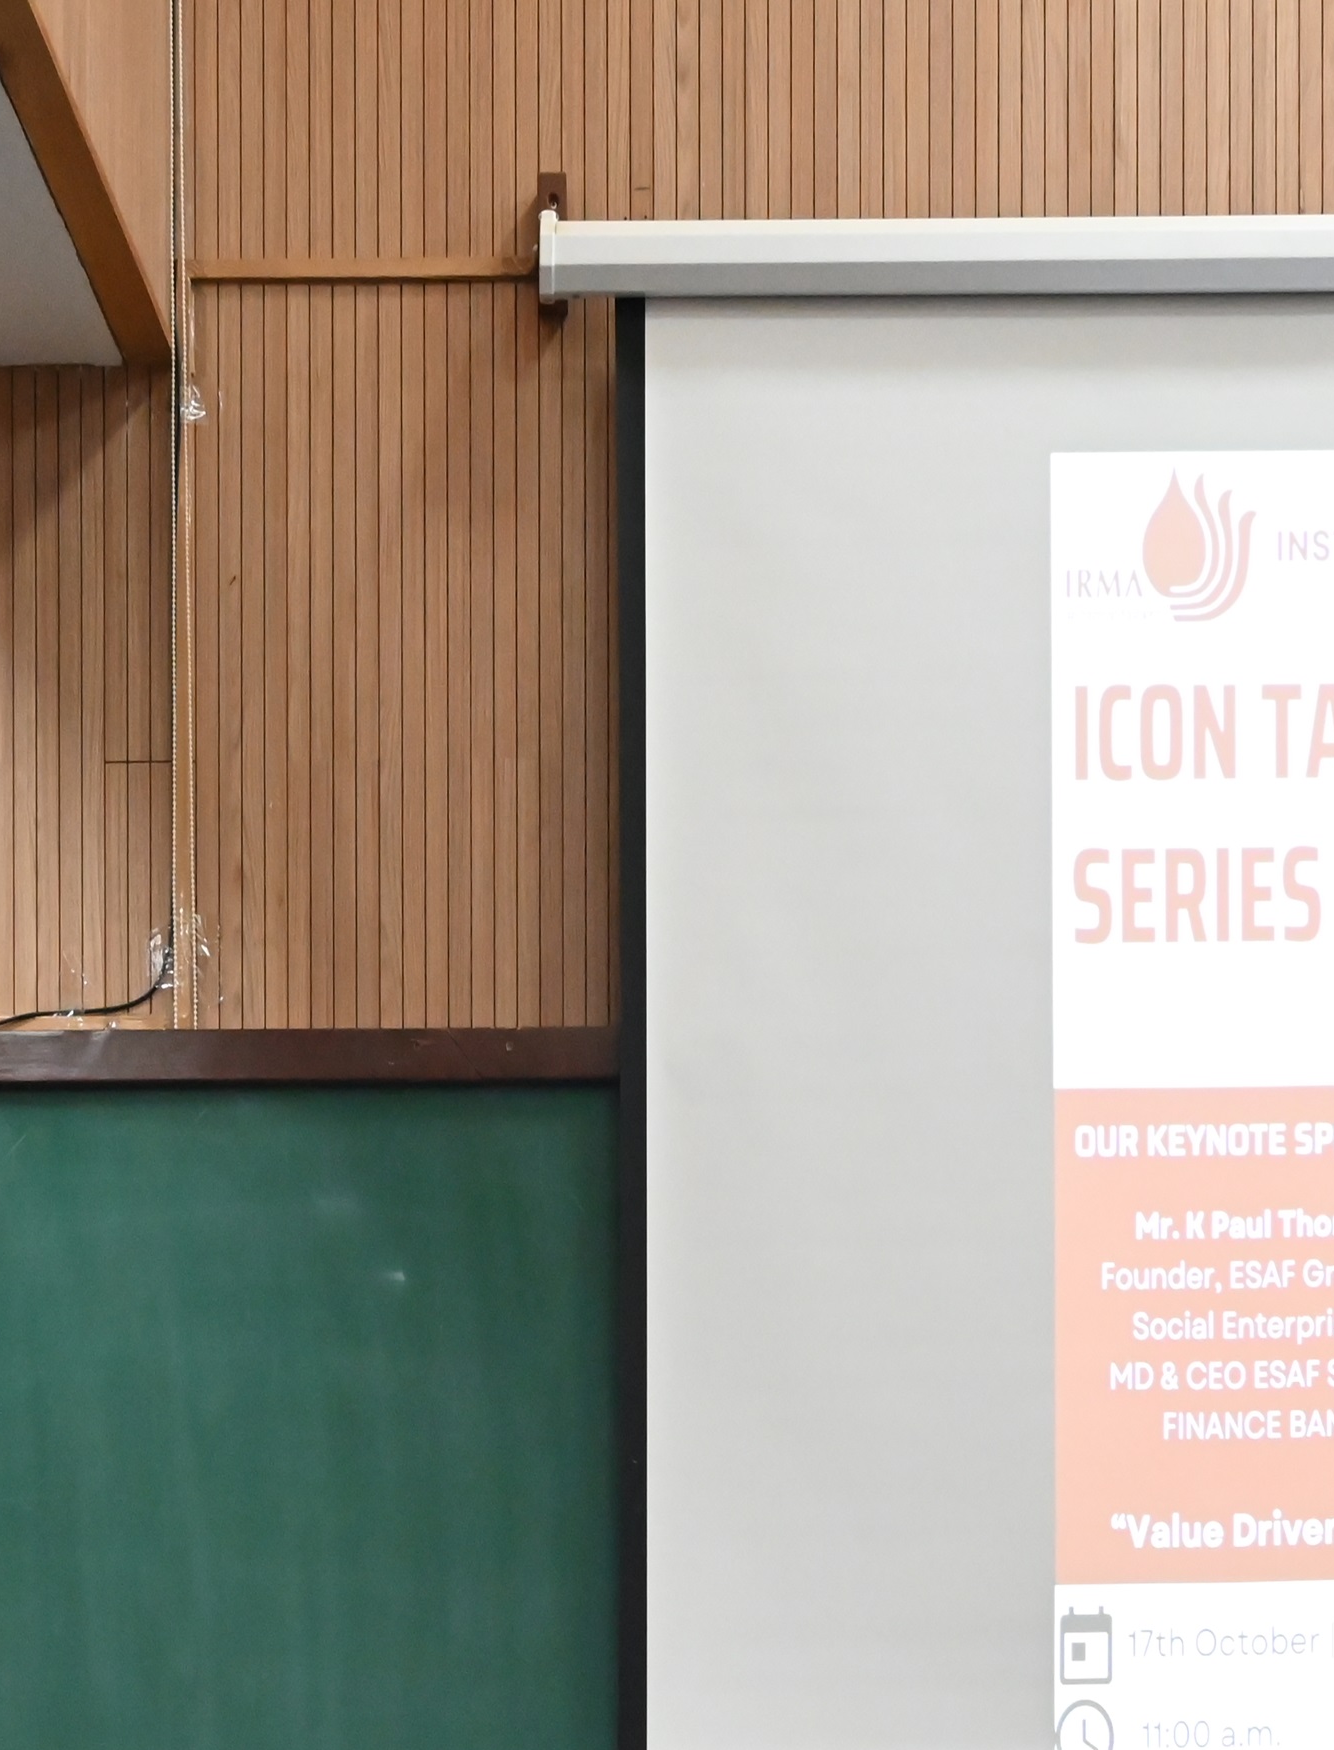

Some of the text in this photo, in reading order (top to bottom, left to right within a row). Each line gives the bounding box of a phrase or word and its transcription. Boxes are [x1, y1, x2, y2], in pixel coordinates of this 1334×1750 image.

[1067, 570, 1142, 597] IRMA
[1075, 684, 1236, 781] ICON
[1074, 846, 1321, 944] SERIES
[1075, 1125, 1139, 1158] OUR
[1147, 1123, 1287, 1157] KEYNOTE
[1135, 1212, 1180, 1240] Mr.
[1185, 1211, 1205, 1239] K
[1211, 1209, 1272, 1239] Paul
[1101, 1260, 1222, 1293] Founder,
[1230, 1260, 1295, 1289] ESAF
[1133, 1310, 1214, 1340] Social
[1110, 1362, 1154, 1390] MD
[1160, 1362, 1179, 1390] &
[1186, 1361, 1247, 1390] CEO
[1254, 1359, 1320, 1389] ESAF
[1163, 1410, 1282, 1440] FINANCE
[1129, 1629, 1184, 1656] 17th
[1196, 1627, 1319, 1656] October
[1143, 1721, 1280, 1748] 11:00 a.m.
